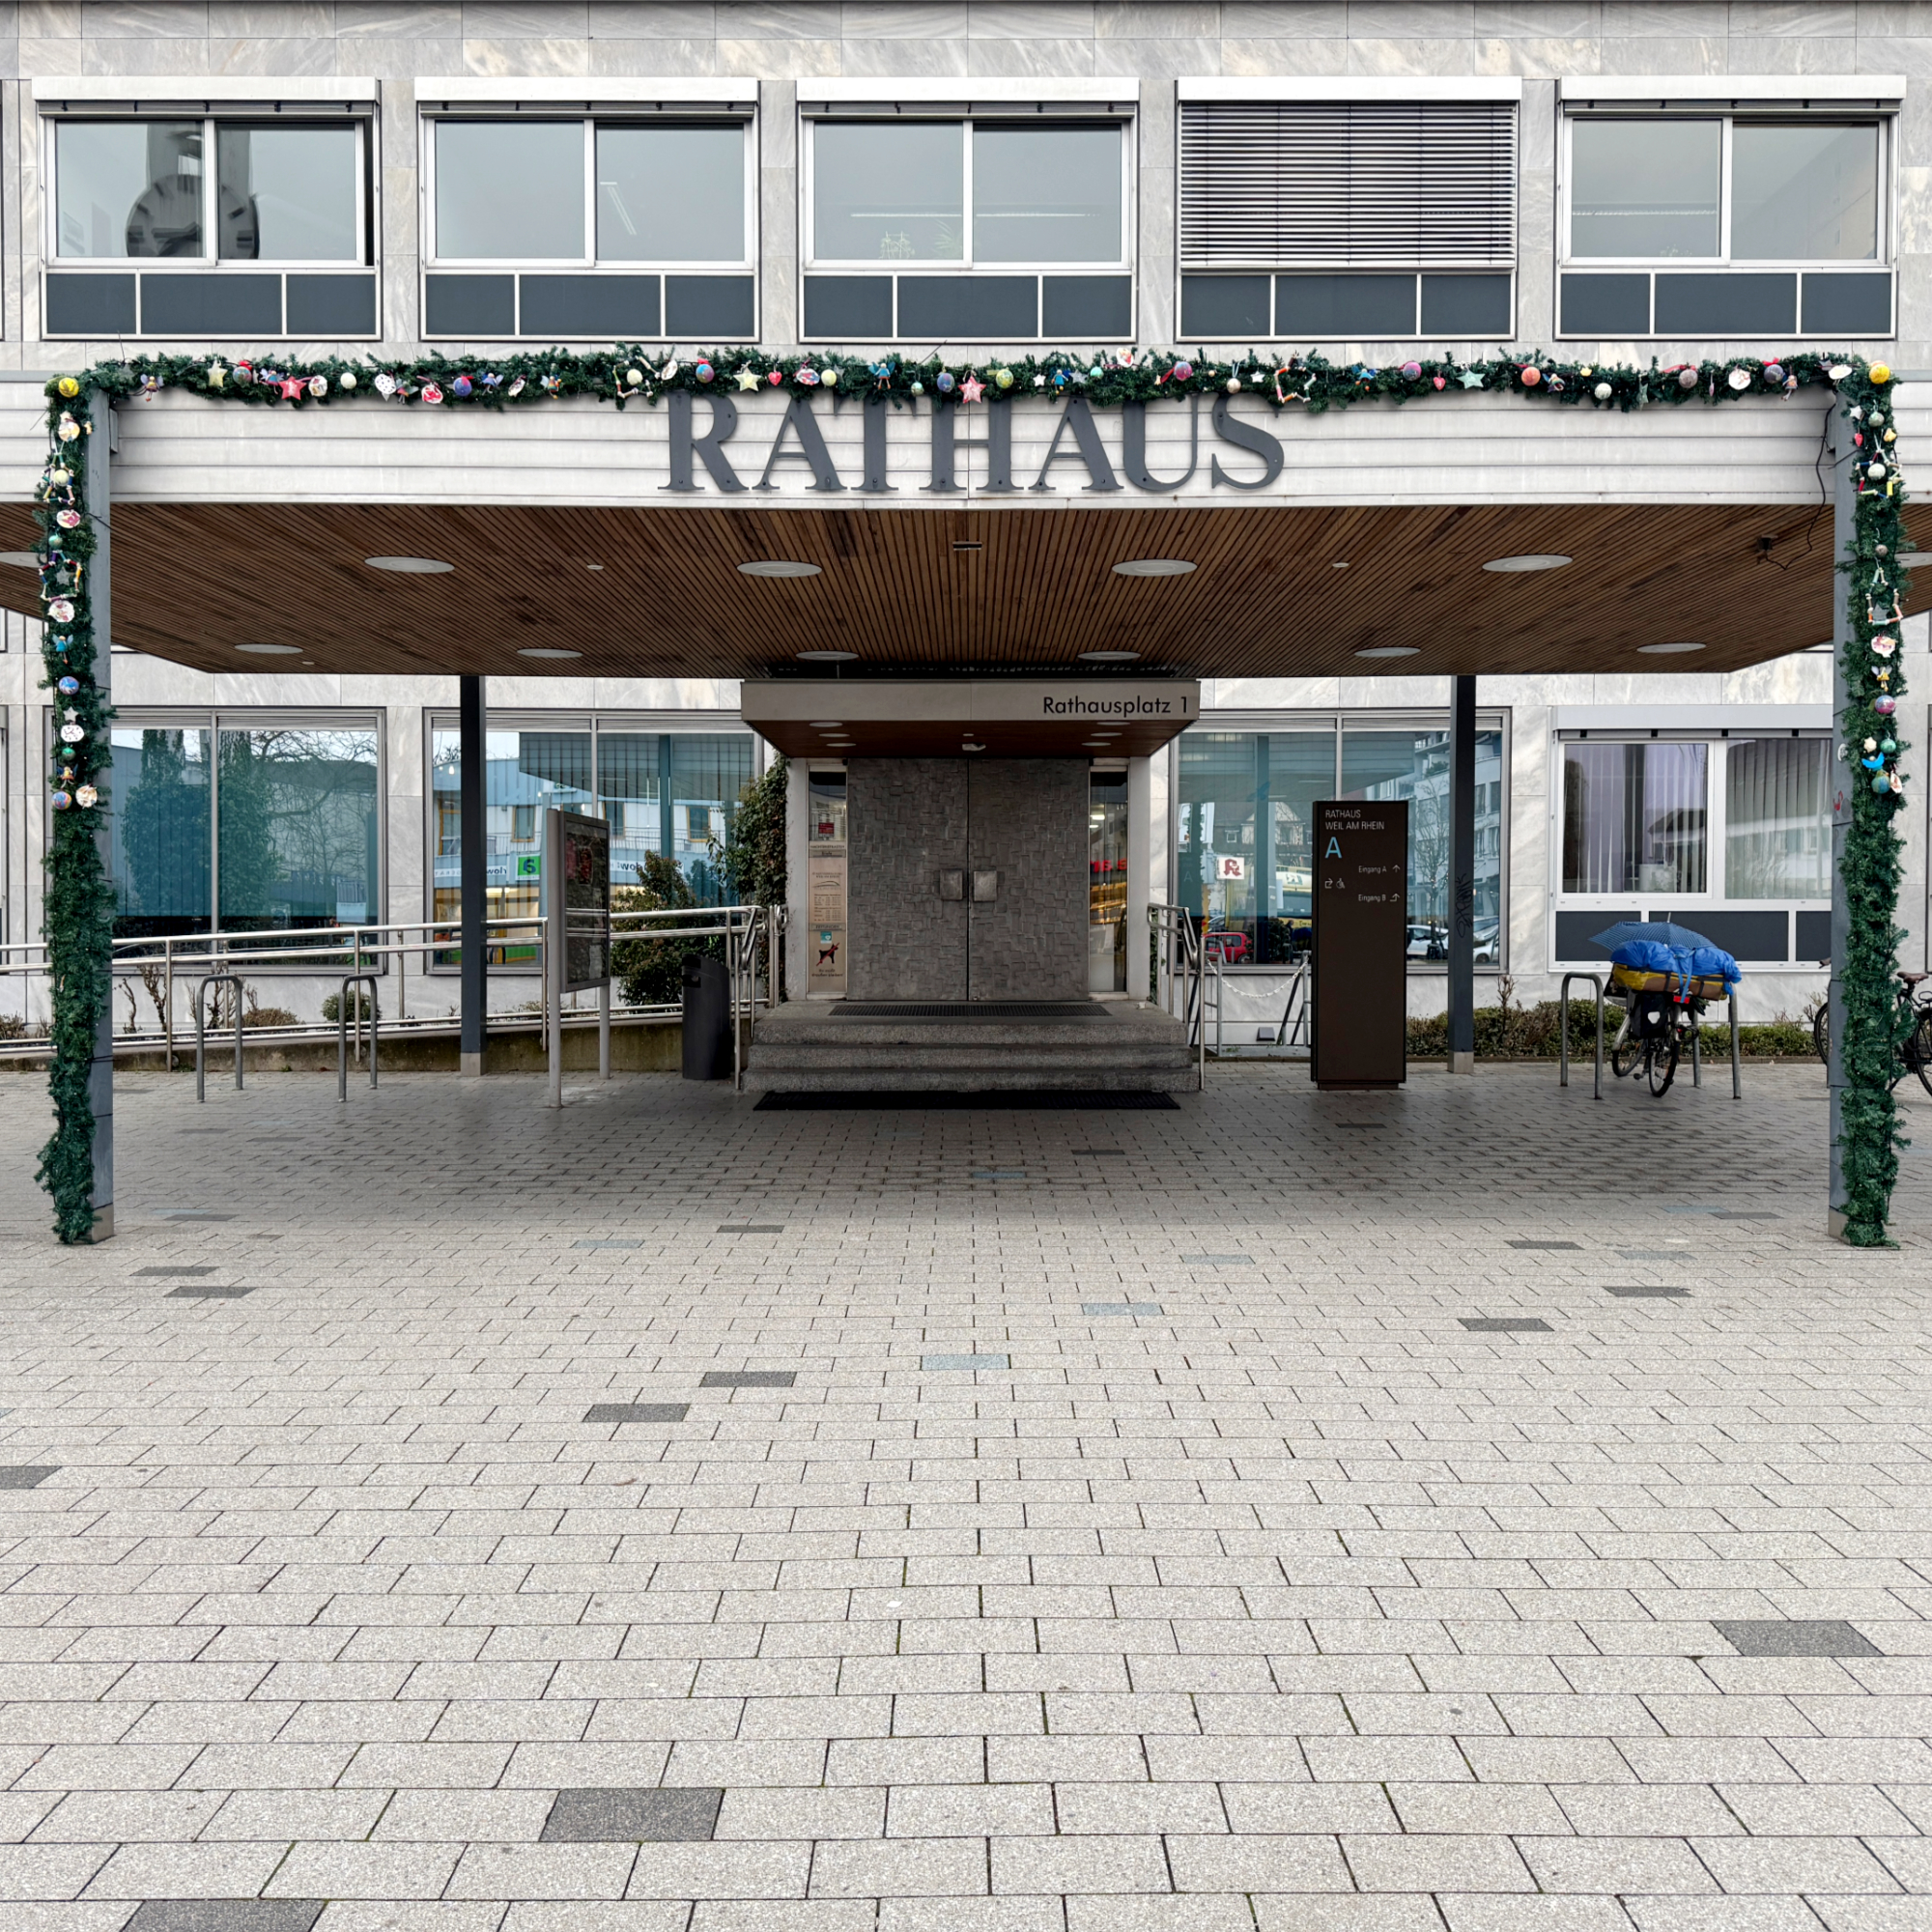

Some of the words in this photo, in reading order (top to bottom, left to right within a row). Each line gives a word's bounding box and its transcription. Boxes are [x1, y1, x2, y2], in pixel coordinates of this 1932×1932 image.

[658, 391, 1285, 492] RATHAUS
[1043, 696, 1172, 718] Rathausplatz
[1180, 696, 1187, 713] 1
[1324, 810, 1361, 818] RATHAUS
[1324, 821, 1344, 830] WEIL
[1346, 821, 1359, 830] AM
[1361, 821, 1384, 830] RHEIN
[1324, 837, 1342, 859] A
[1358, 866, 1381, 874] Eingang
[1358, 894, 1381, 902] Eingang
